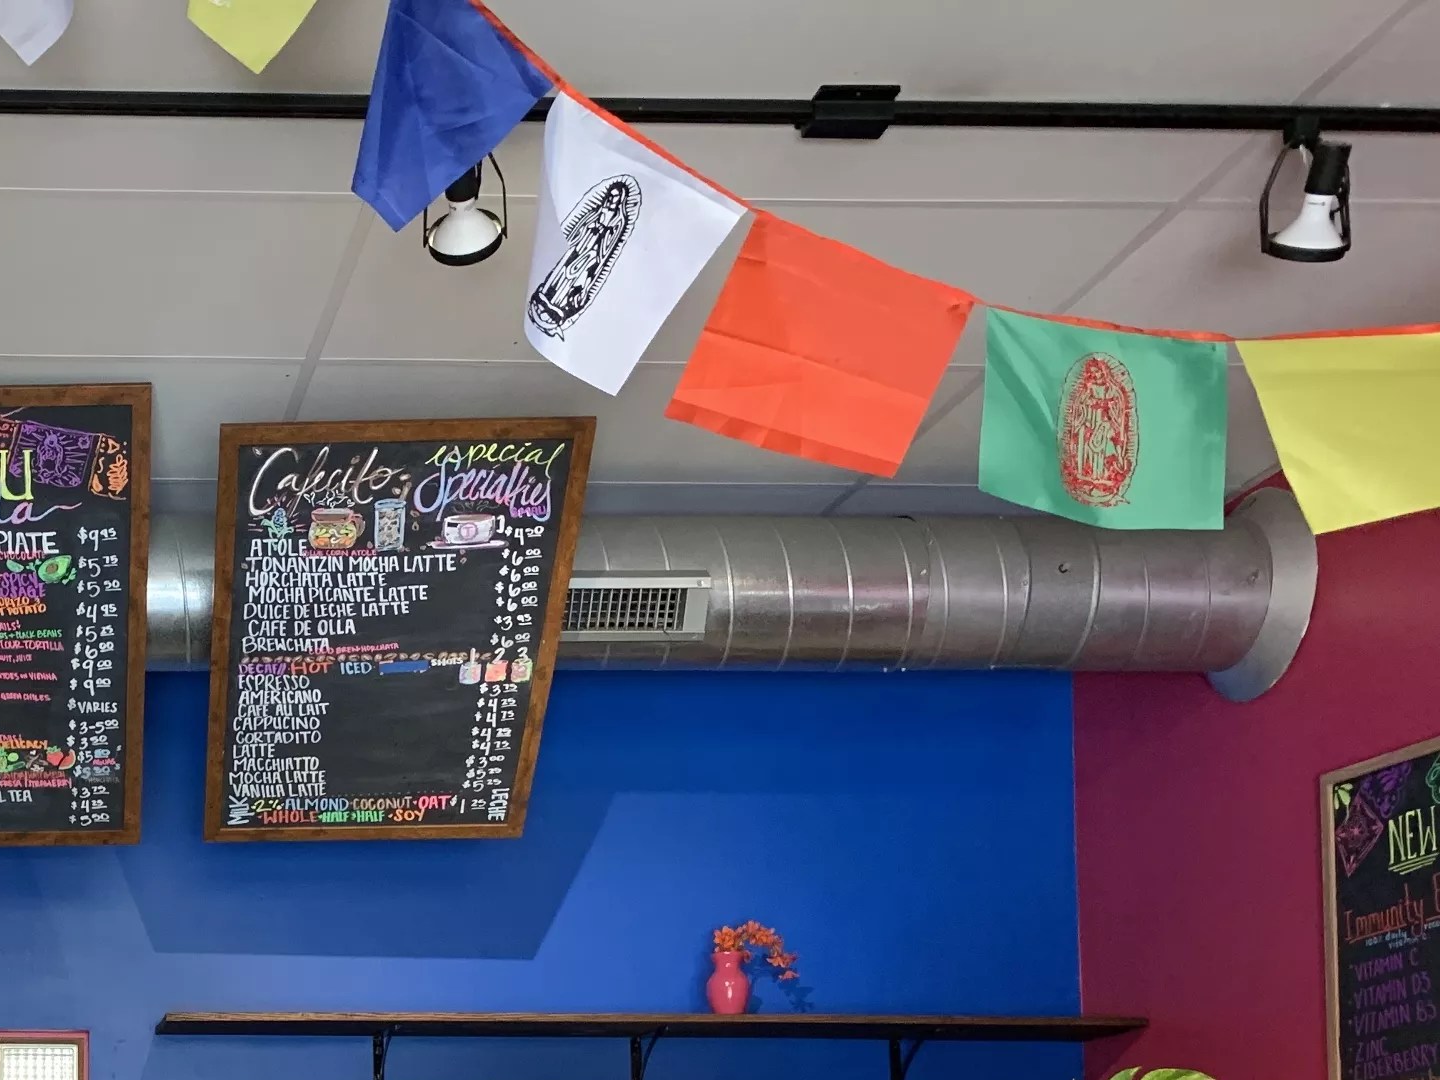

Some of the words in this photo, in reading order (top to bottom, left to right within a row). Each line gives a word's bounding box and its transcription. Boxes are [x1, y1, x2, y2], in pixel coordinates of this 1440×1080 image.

[425, 442, 566, 481] especial
[248, 446, 404, 519] Cafecito
[413, 446, 552, 523] Specialties
[250, 538, 308, 558] ATOLE
[246, 556, 344, 574] TONANTZIN
[349, 556, 399, 574] MOCHA
[403, 554, 457, 573] LATTE
[245, 571, 333, 589] HORCHATA
[337, 572, 388, 589] LATTE
[248, 586, 306, 604] MOCHA
[308, 587, 376, 603] PICANTE
[379, 585, 429, 603] LATTE
[294, 604, 311, 620] DE
[313, 603, 357, 618] LECHE
[361, 602, 410, 617] LATTE
[248, 620, 288, 638] CAFE
[294, 621, 312, 637] DE
[317, 619, 357, 636] OLLA
[242, 636, 331, 654] BREWCHATA
[290, 661, 332, 676] HOT
[340, 661, 373, 676] ICED
[238, 674, 310, 692] ESPRESSO
[238, 689, 323, 706] AMERICANO
[238, 703, 270, 719] CAFE
[276, 704, 293, 718] AU
[298, 702, 330, 717] LAIT
[232, 714, 320, 732] CAPPUCINO
[236, 730, 322, 745] CORTADITO
[232, 743, 276, 760] LATTE
[234, 757, 320, 773] MACCHIATTO
[228, 771, 283, 786] MOCHA
[285, 770, 327, 785] LATTE
[8, 790, 33, 803] TEA
[232, 783, 286, 799] VANILLA
[288, 783, 327, 798] LATTE
[285, 798, 350, 813] ALMOND
[352, 796, 412, 811] COCONUT
[418, 795, 452, 811] OAT
[486, 787, 511, 822] LECHE
[263, 810, 320, 825] WHOLE
[322, 811, 351, 824] HALF
[359, 810, 386, 824] HALF
[394, 806, 428, 822] SOY
[1388, 804, 1439, 866] NEW
[1344, 883, 1426, 943] Immunity
[1354, 951, 1404, 983] VITAMIN
[1409, 946, 1421, 972] C
[1353, 978, 1409, 1010] VITAMIN
[1353, 1004, 1411, 1037] VITAMIN
[1355, 1035, 1389, 1063] ZINC
